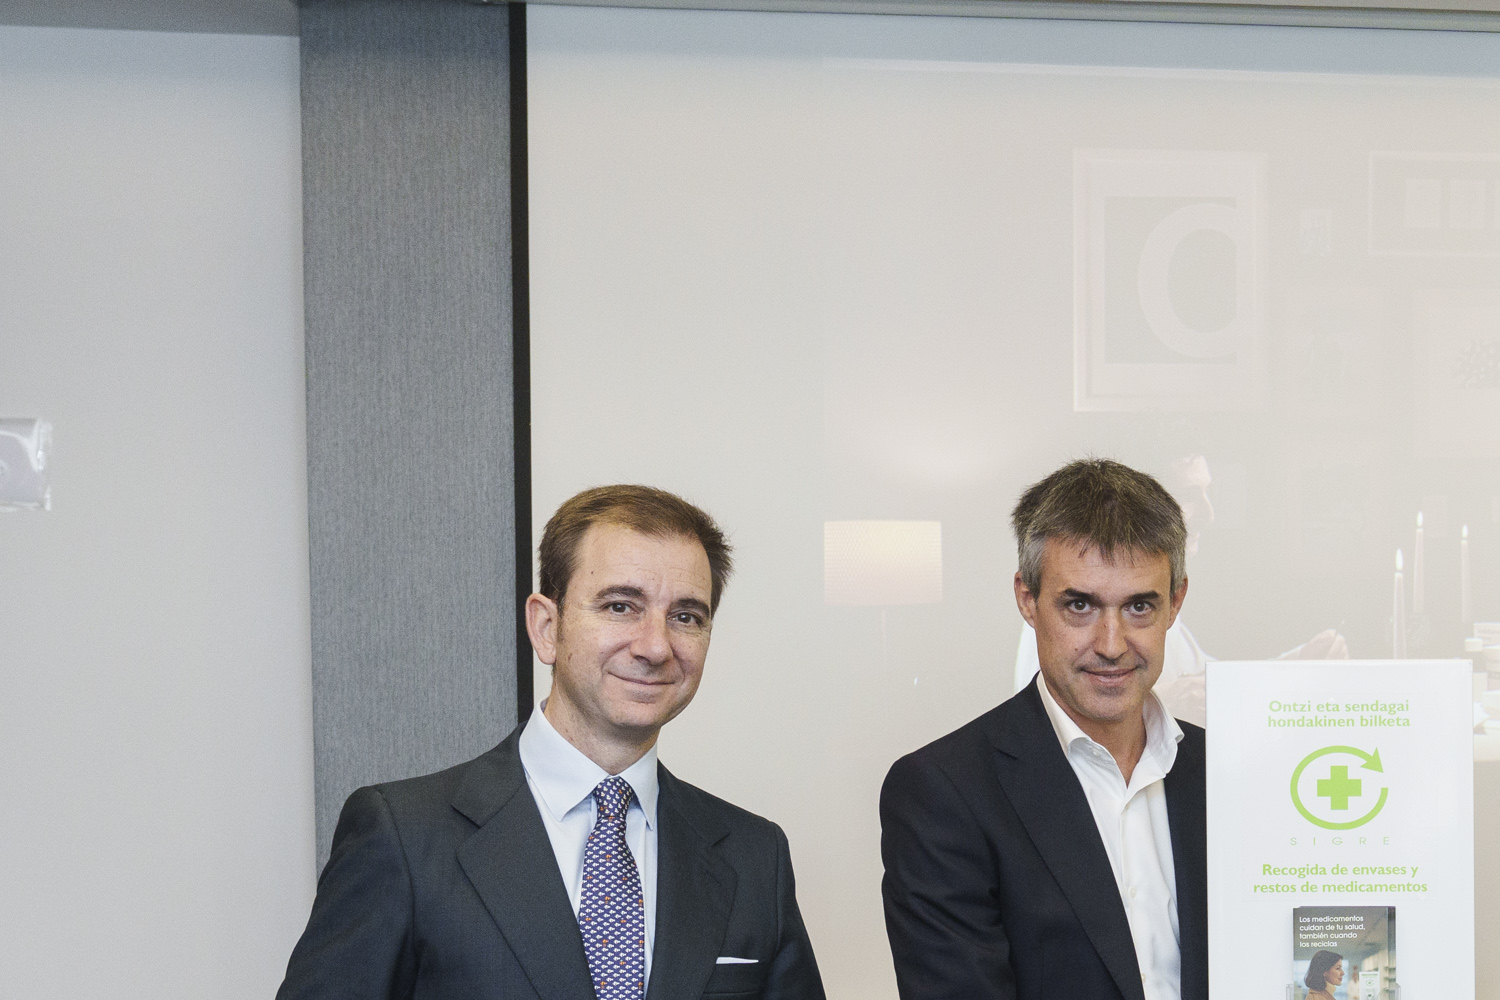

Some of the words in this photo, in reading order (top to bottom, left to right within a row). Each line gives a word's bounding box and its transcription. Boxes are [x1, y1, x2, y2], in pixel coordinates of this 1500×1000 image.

[1268, 701, 1311, 712] Ontzi
[1316, 702, 1340, 712] eta
[1345, 700, 1409, 715] sendagai
[1268, 715, 1355, 727] hondakinen
[1360, 714, 1410, 727] bilketa
[1290, 837, 1390, 846] SIGRE
[1262, 864, 1327, 878] Recogida
[1331, 864, 1348, 876] de
[1352, 866, 1407, 875] envases
[1410, 866, 1419, 878] y
[1254, 882, 1296, 893] restos
[1300, 881, 1318, 893] de
[1322, 881, 1428, 892] medicamentos
[1312, 915, 1364, 923] medicamentos
